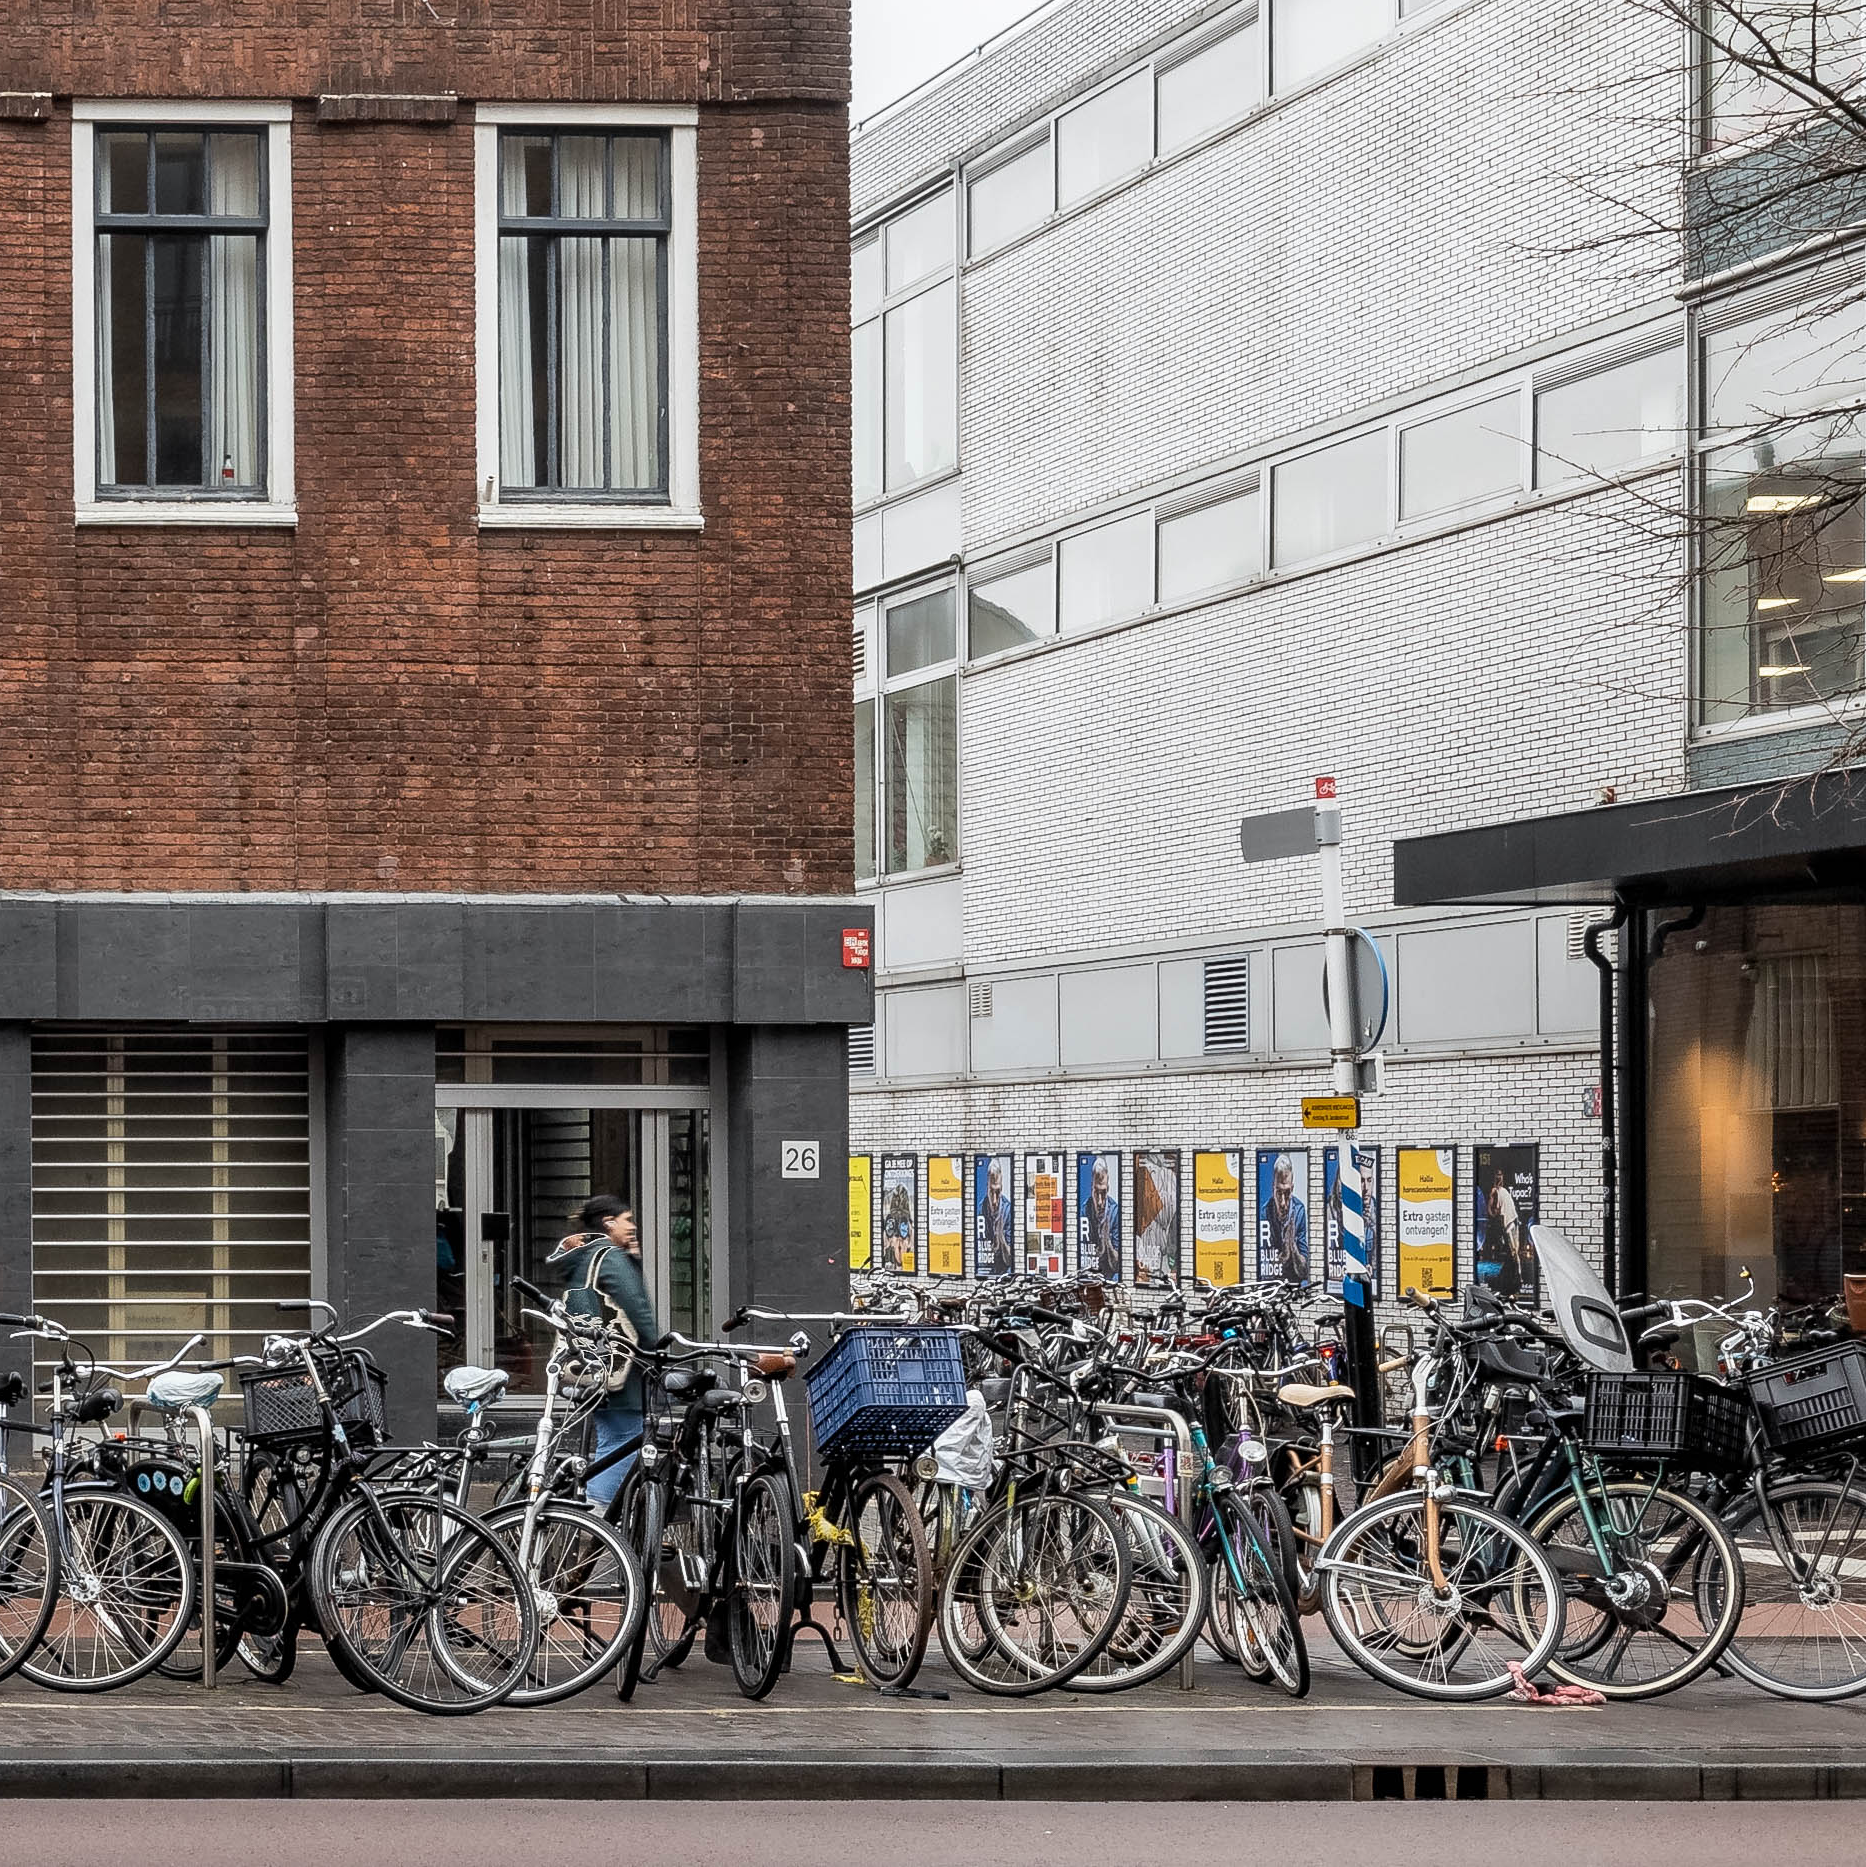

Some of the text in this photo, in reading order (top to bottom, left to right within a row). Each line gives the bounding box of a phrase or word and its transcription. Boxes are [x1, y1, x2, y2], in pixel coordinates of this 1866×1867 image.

[785, 1148, 816, 1171] 26
[1515, 1173, 1533, 1184] Who's
[1508, 1186, 1532, 1201] Tupac?
[1198, 1209, 1216, 1220] Extra
[1403, 1210, 1451, 1225] Extra gasten
[1405, 1224, 1449, 1238] ontvangen?
[1260, 1249, 1279, 1262] BLUE
[1260, 1263, 1284, 1276] RIDGE
